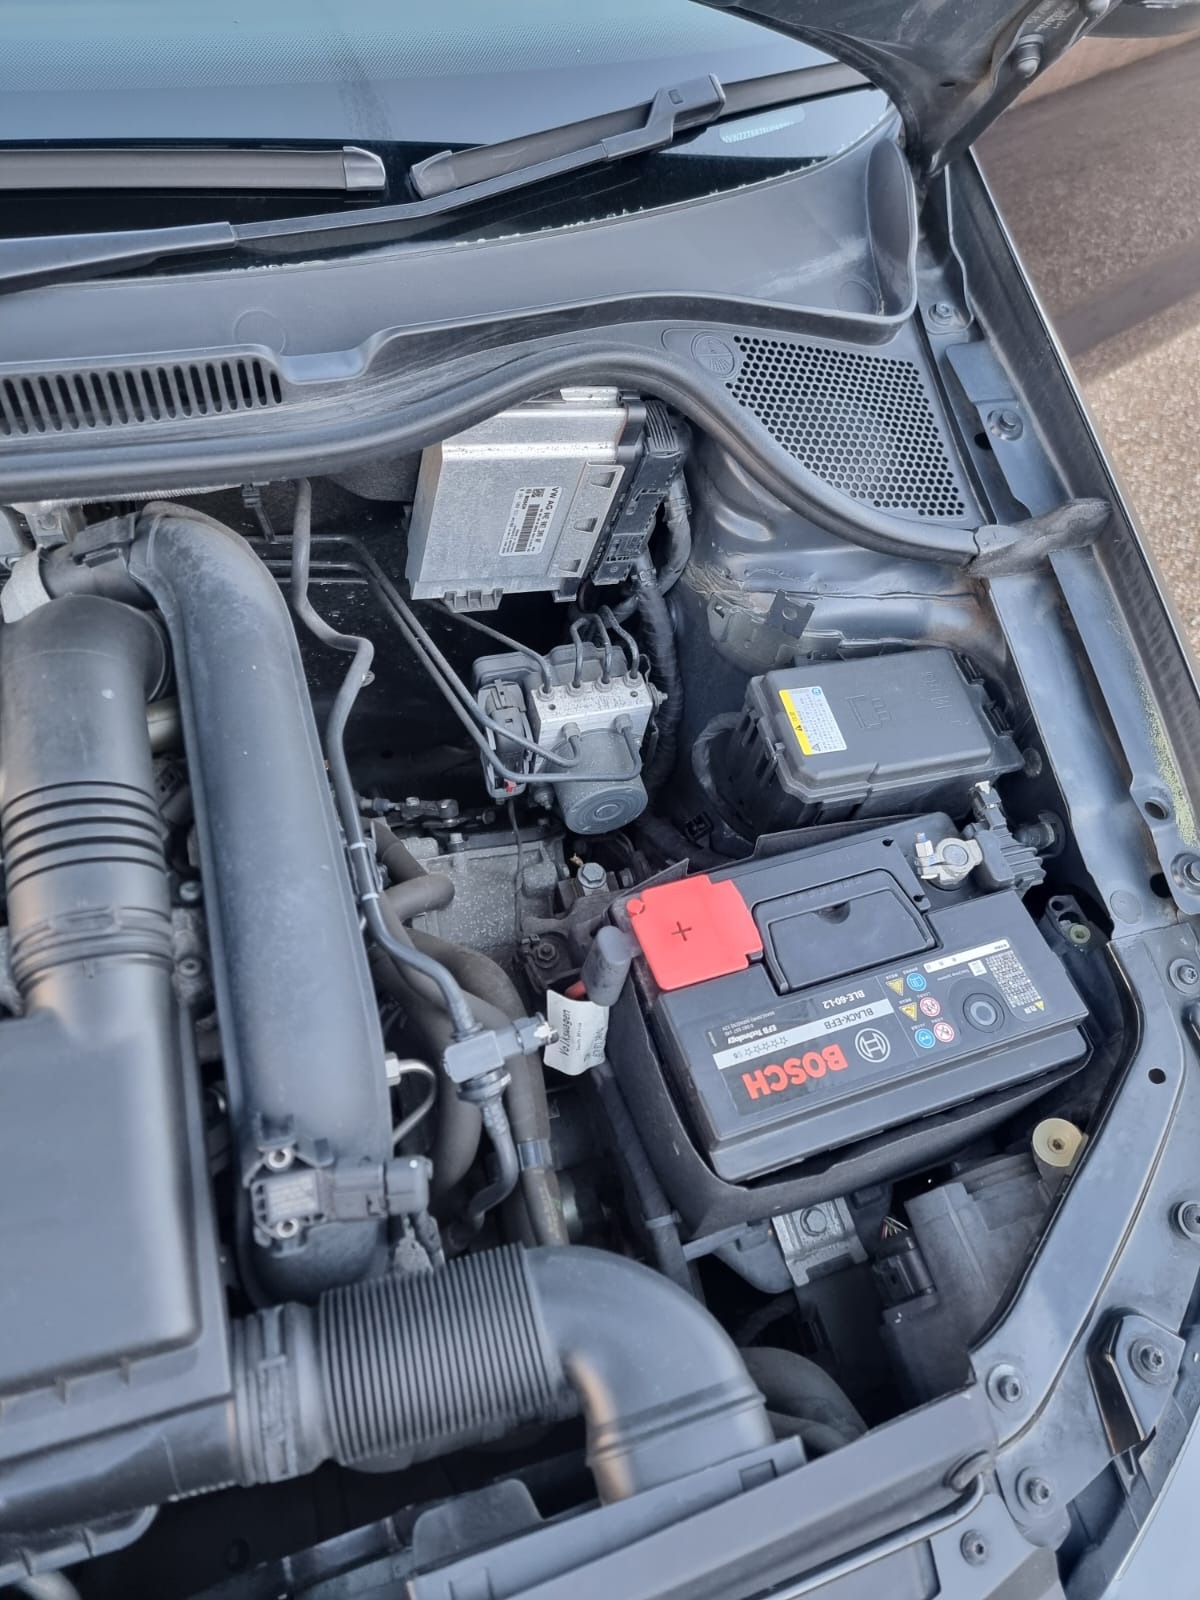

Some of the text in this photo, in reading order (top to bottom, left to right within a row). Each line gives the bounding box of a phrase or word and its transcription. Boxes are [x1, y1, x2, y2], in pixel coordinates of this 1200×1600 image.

[545, 486, 560, 510] VW AG
[822, 989, 866, 1010] BLE-60-L2
[560, 1009, 572, 1057] Volkswagen
[727, 1029, 763, 1045] Technology
[742, 1043, 848, 1100] BOSCH
